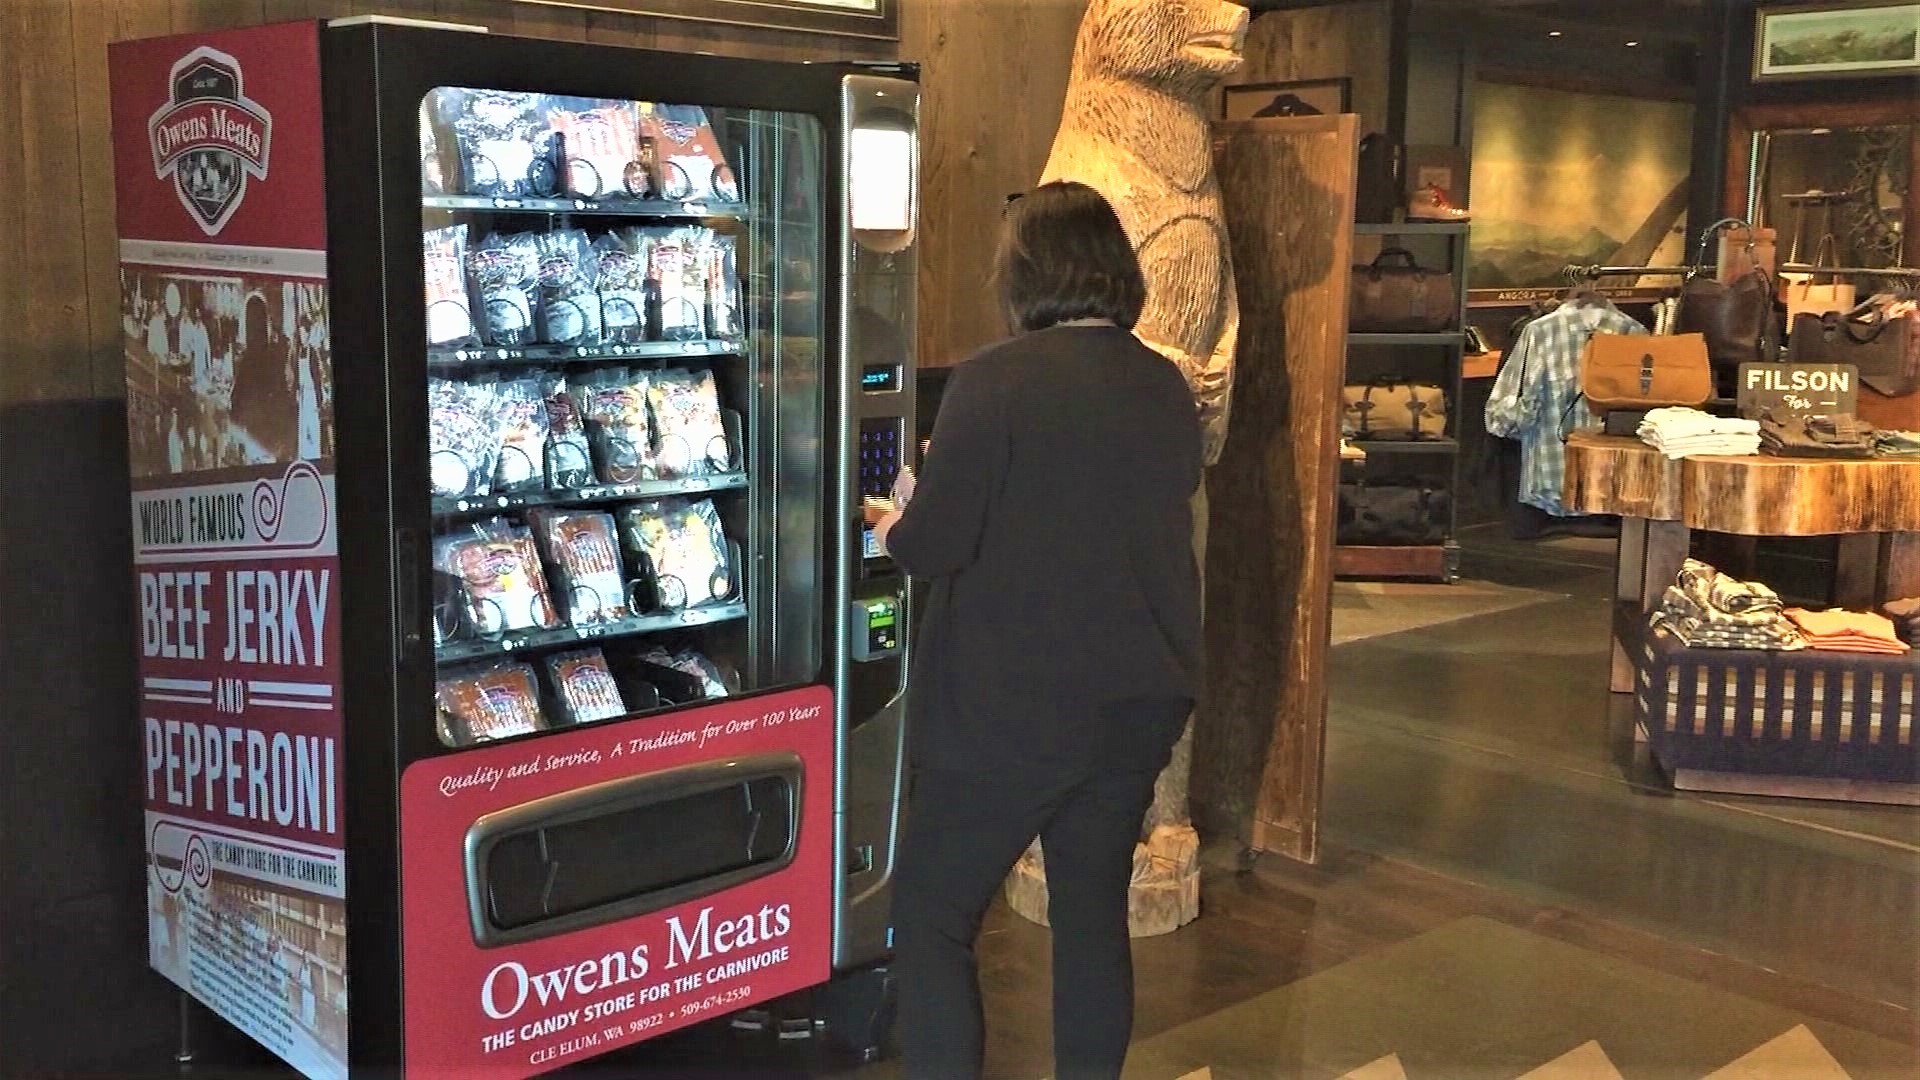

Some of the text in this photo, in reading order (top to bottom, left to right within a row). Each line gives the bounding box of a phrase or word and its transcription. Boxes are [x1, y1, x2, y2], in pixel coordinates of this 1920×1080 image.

[158, 107, 261, 157] Owens Meats
[1747, 369, 1849, 392] FILSON
[139, 492, 245, 545] WORLD FAMOUS
[140, 569, 330, 667] BEEF JERKY
[217, 677, 244, 714] AND
[145, 717, 336, 834] PEPPERONI
[439, 765, 503, 797] Quality
[506, 755, 541, 778] and
[611, 743, 625, 758] A
[629, 728, 697, 755] Tradition
[699, 722, 724, 749] for
[725, 718, 758, 736] Over
[761, 711, 785, 728] 100
[788, 705, 821, 724] Years
[246, 847, 267, 873] STORE
[268, 852, 281, 876] FOR
[282, 855, 295, 879] THE
[297, 859, 337, 888] CARNIVORE
[480, 902, 791, 1020] Owens Meats
[481, 946, 790, 1053] THE CANDY STORE FOR THE CARNIVORE
[529, 985, 751, 1065] CLE ELUM, WA 98922 509-674-2530
